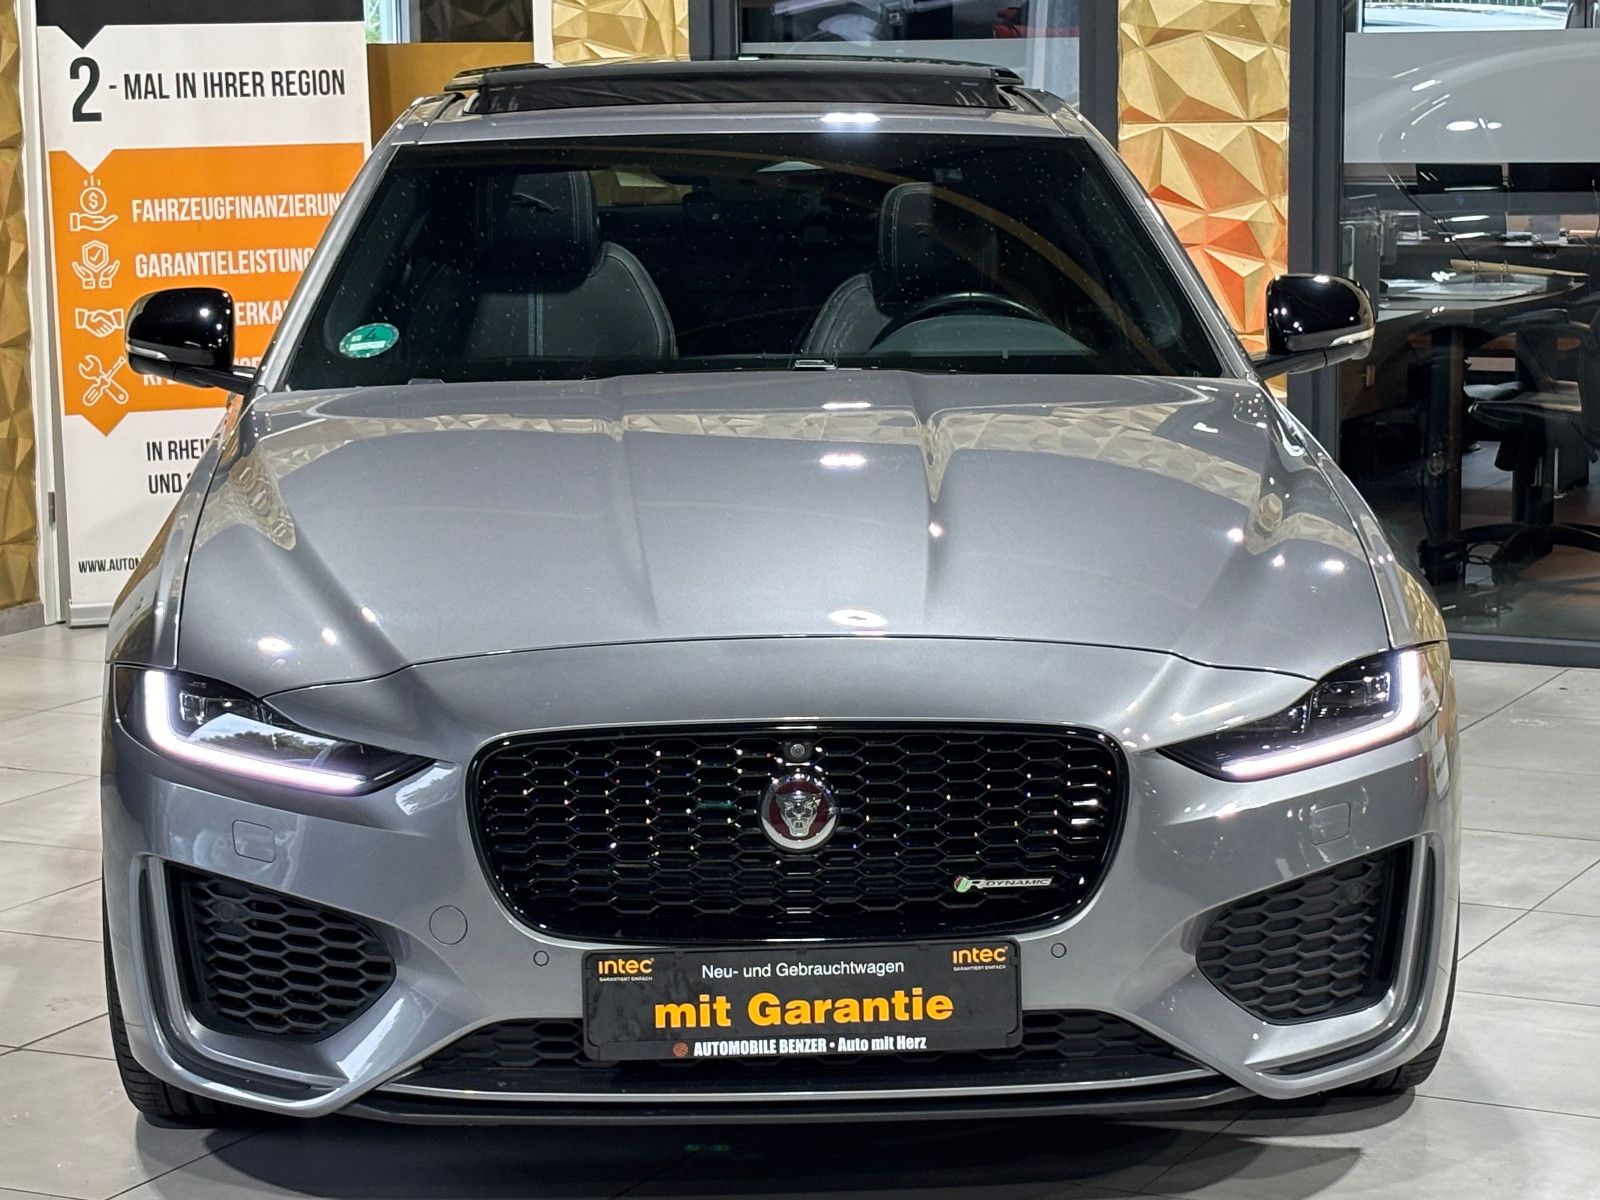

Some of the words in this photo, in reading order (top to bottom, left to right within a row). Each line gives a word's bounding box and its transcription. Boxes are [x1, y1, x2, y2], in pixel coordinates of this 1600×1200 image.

[69, 56, 102, 122] 2
[124, 73, 170, 100] MAL
[175, 72, 197, 99] IN
[203, 70, 265, 98] IHRER
[272, 69, 345, 97] REGION
[234, 300, 289, 326] ERKA
[146, 441, 163, 461] IN
[148, 473, 183, 494] UND
[953, 946, 1008, 964] intec
[598, 958, 654, 974] intec
[702, 964, 738, 979] Neu-
[743, 963, 771, 978] und
[776, 960, 904, 977] Gebrauchtwagen
[655, 994, 731, 1029] mit
[748, 987, 954, 1027] Garantie
[694, 1039, 776, 1056] AUTOMOBILE
[779, 1037, 827, 1053] BENZER
[838, 1037, 867, 1051] Auto
[871, 1036, 894, 1050] mit
[897, 1035, 926, 1049] Herz
